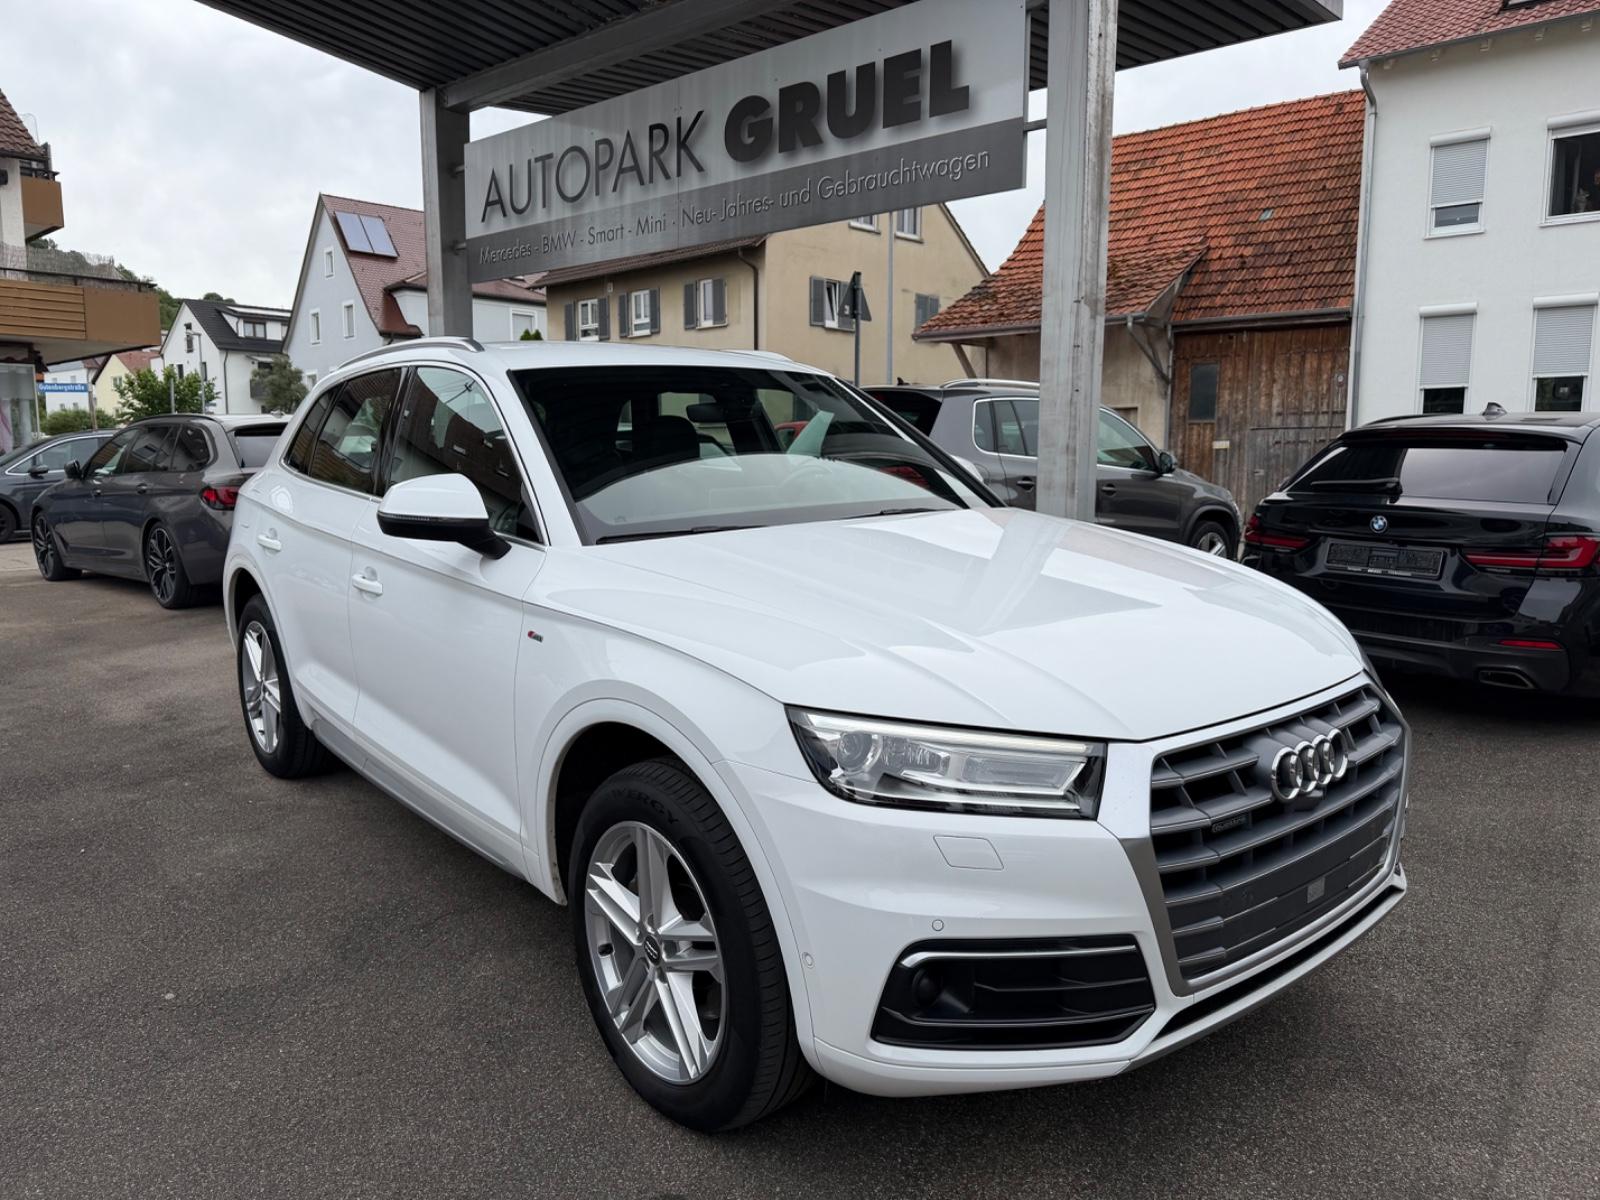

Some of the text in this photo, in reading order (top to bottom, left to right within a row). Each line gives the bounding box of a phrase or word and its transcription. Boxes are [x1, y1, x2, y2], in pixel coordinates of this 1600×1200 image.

[480, 39, 970, 223] AUTOPARK GRUEL
[480, 240, 531, 264] Mercedes
[542, 230, 577, 255] BMW
[587, 225, 624, 246] Smart
[635, 213, 667, 237] Mini
[681, 205, 719, 228] Neu-
[719, 192, 775, 222] Jahres-
[779, 180, 811, 208] und
[816, 150, 991, 199] Gebrauchtwagen
[39, 383, 85, 391] Gutenbergstraße
